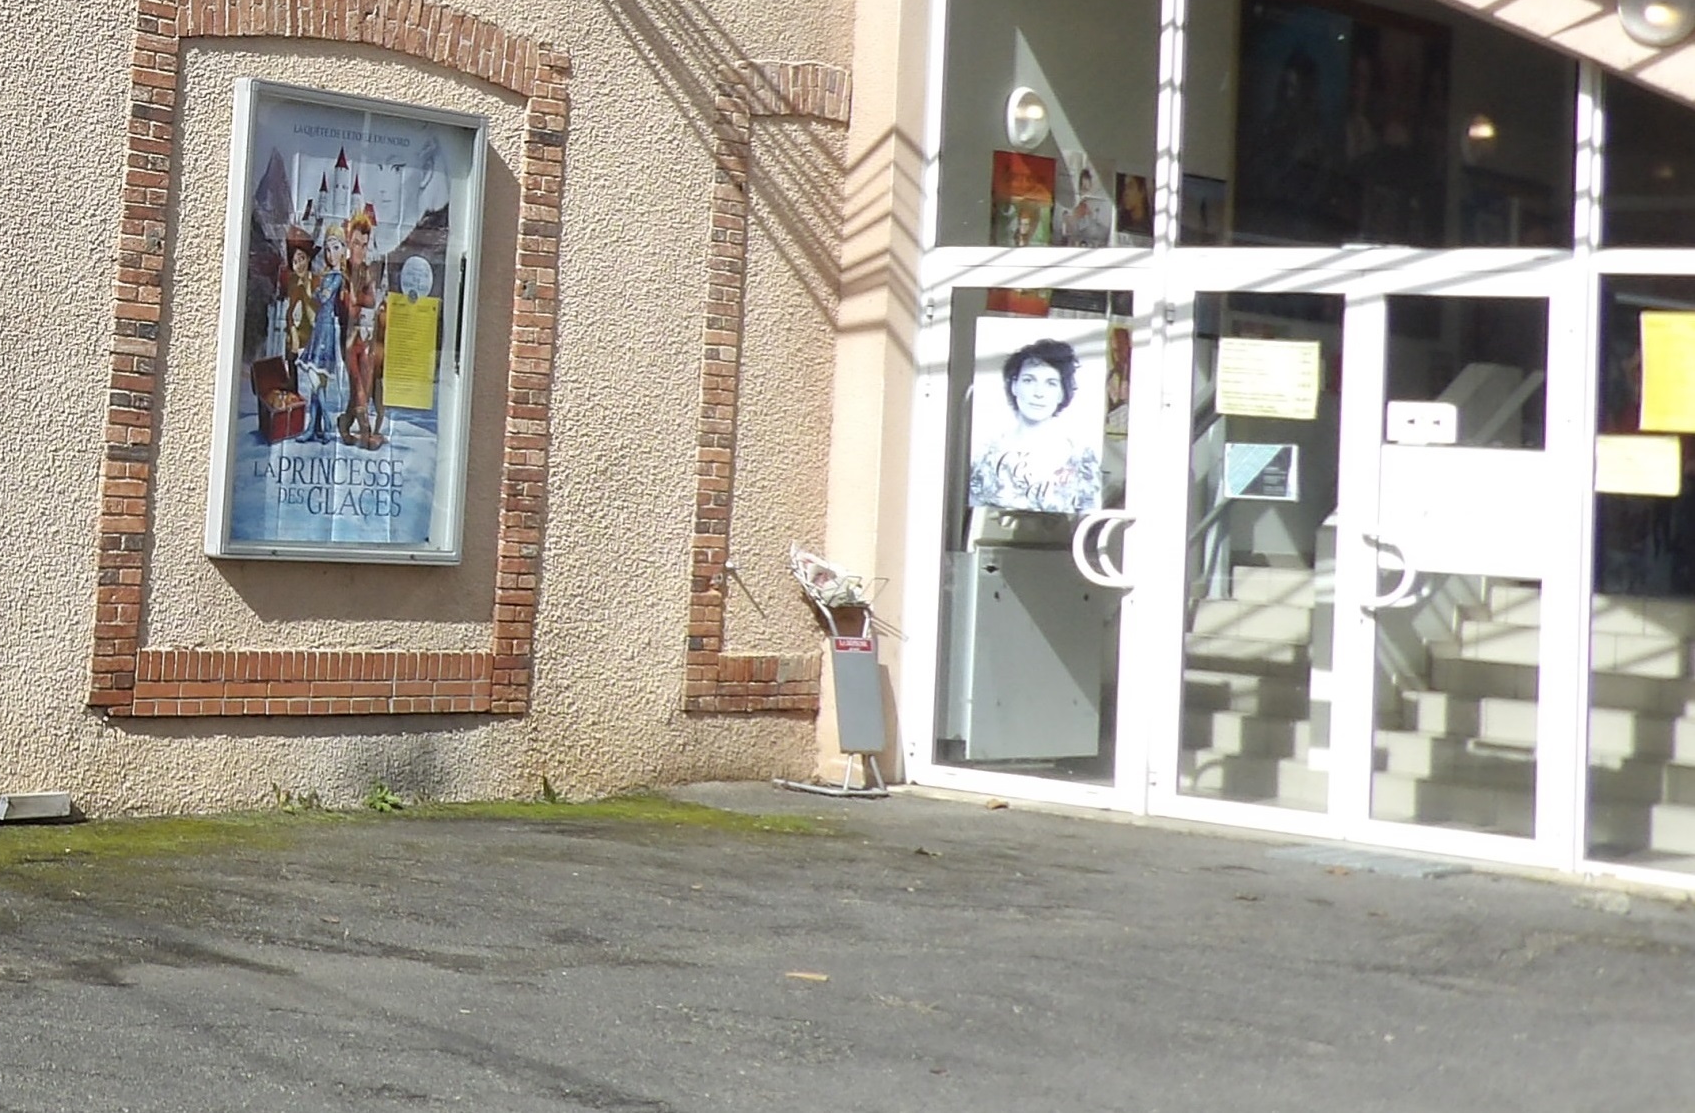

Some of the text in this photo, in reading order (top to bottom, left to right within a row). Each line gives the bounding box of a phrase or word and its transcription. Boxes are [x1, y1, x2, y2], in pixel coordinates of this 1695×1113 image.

[254, 456, 404, 488] LA PRINCESSE
[278, 487, 305, 505] DES
